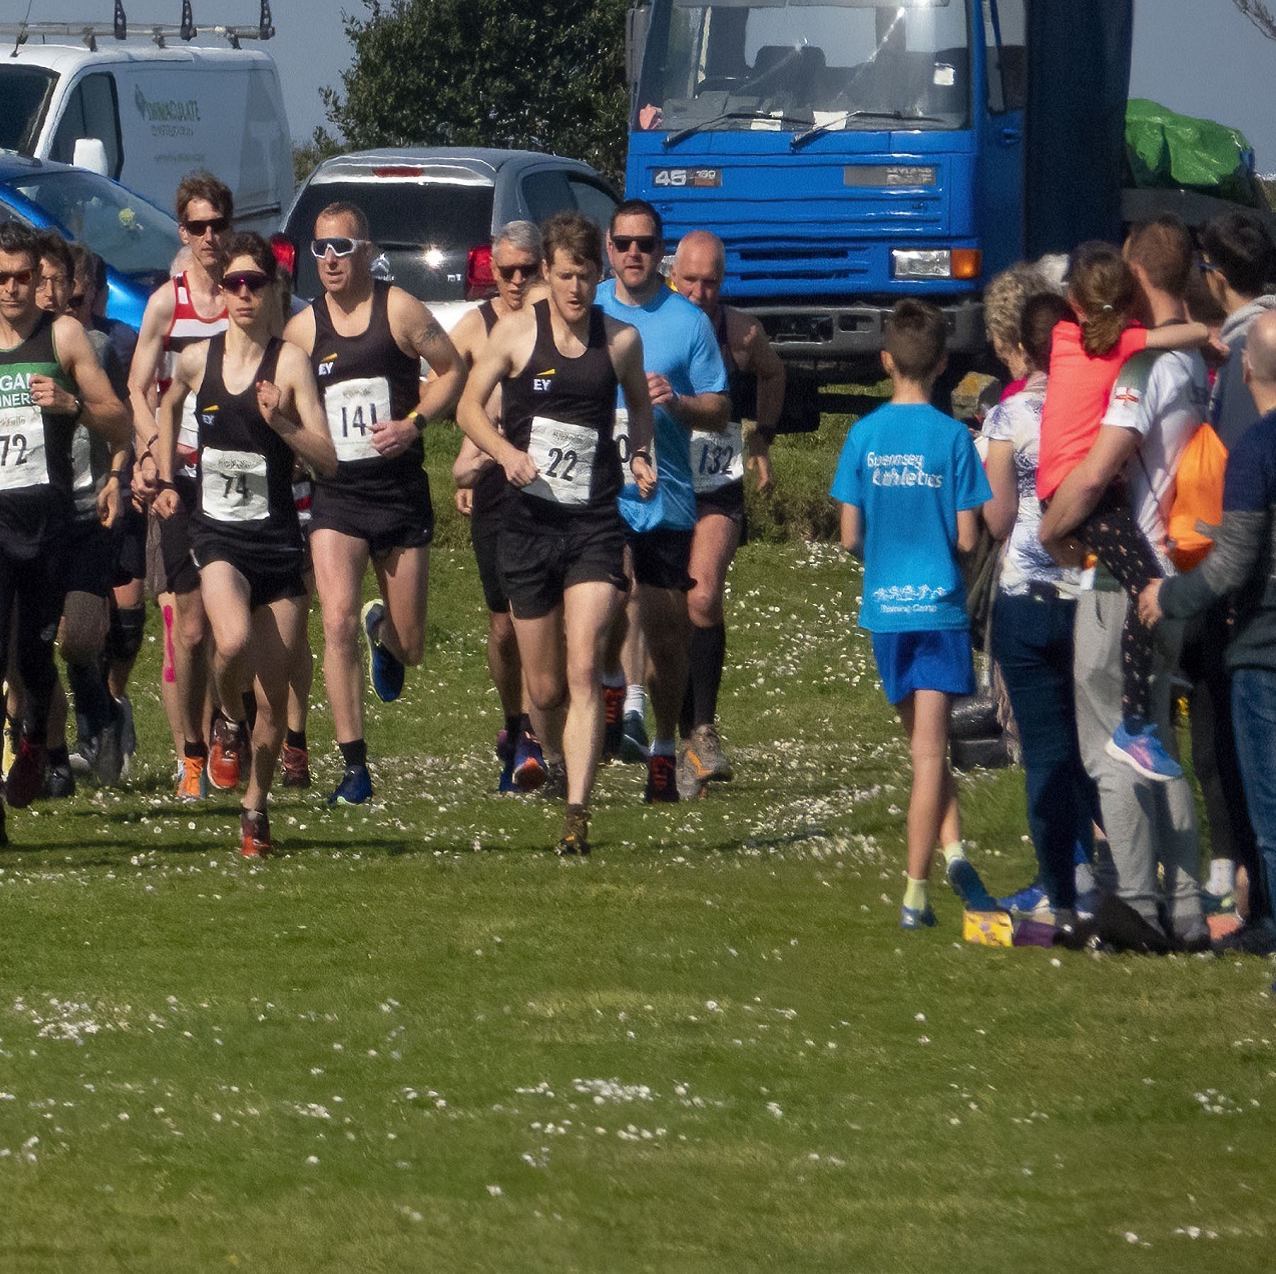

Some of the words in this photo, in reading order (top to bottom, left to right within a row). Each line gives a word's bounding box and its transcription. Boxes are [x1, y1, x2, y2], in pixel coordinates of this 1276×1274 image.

[533, 378, 551, 391] EY
[342, 403, 378, 437] 141
[546, 447, 577, 482] 22
